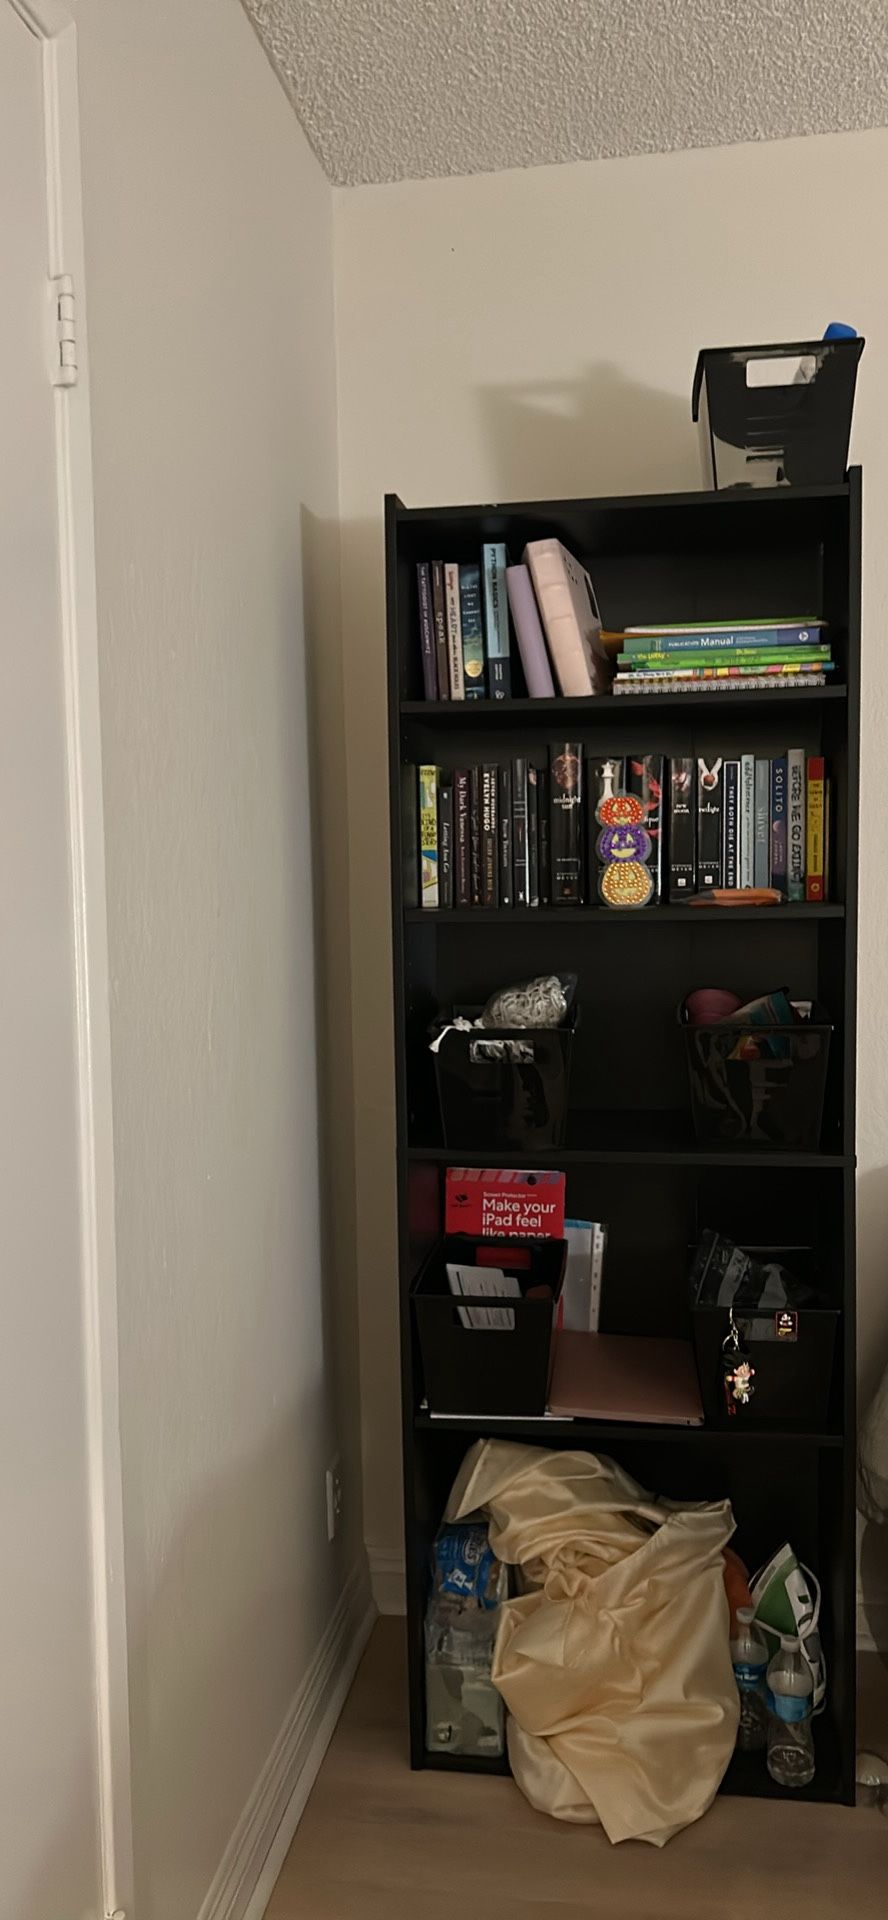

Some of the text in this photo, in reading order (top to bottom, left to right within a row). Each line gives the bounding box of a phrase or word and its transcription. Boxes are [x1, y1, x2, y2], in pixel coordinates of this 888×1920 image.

[436, 611, 445, 644] speak
[700, 636, 734, 647] Manual
[457, 776, 467, 788] My
[775, 767, 784, 813] SOLITO
[791, 765, 802, 801] BEFORE
[458, 790, 468, 810] Dark
[553, 793, 581, 805] midnight
[791, 805, 802, 821] WE
[791, 825, 802, 841] GO
[728, 843, 735, 853] AT
[482, 1199, 520, 1212] Make
[523, 1203, 556, 1216] your
[482, 1213, 541, 1228] iPad feel
